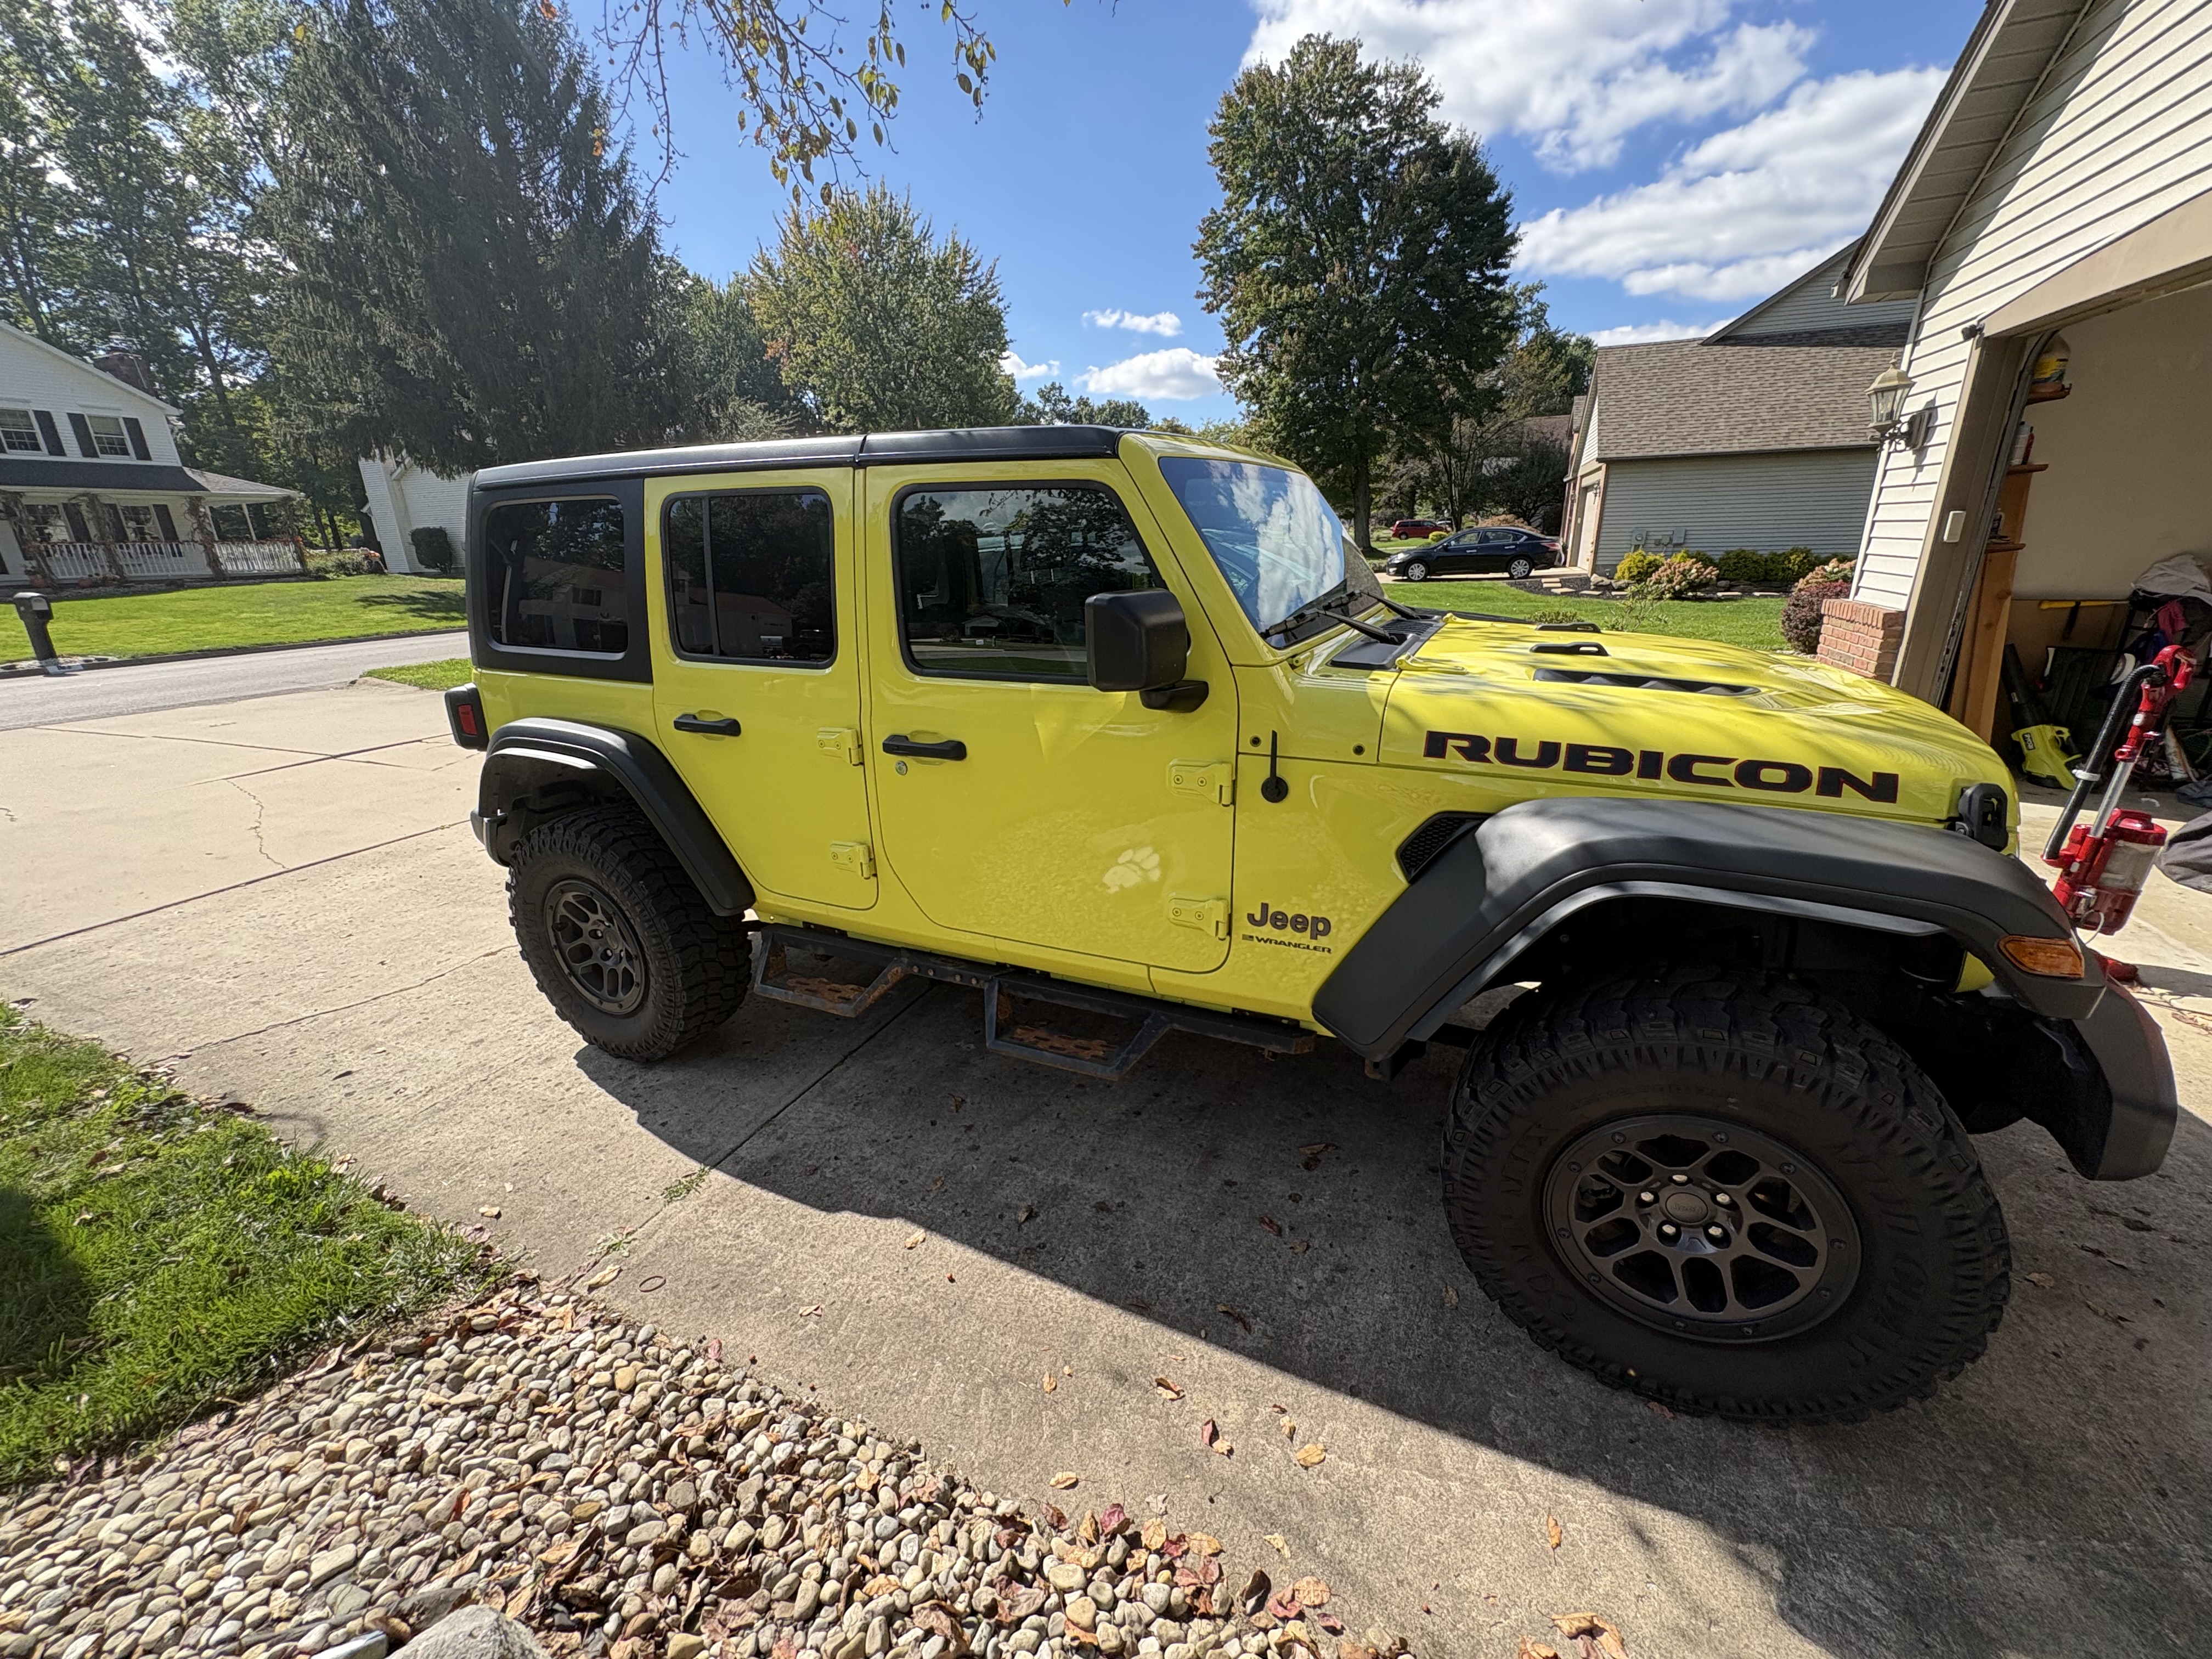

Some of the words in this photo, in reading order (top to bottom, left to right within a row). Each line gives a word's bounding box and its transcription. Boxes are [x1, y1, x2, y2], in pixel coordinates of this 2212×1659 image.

[1423, 730, 1899, 804] RUBICON
[1247, 902, 1331, 940] Jeep
[1255, 936, 1332, 954] WRANGLER
[1671, 1202, 1704, 1214] Jeep
